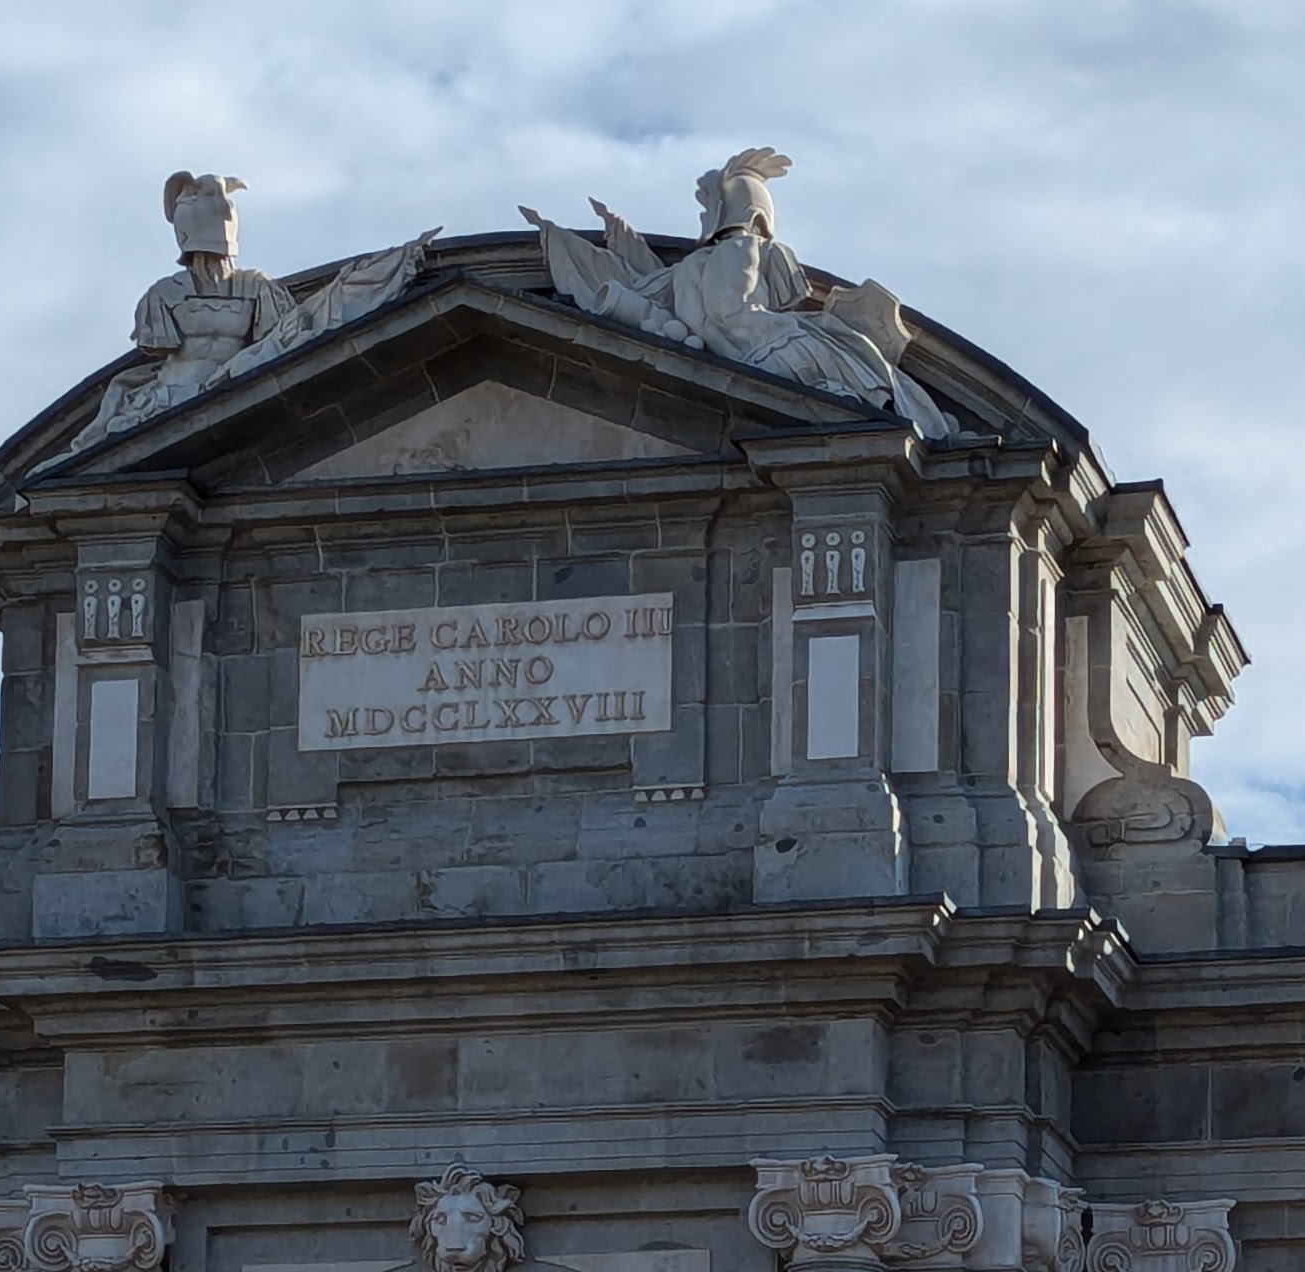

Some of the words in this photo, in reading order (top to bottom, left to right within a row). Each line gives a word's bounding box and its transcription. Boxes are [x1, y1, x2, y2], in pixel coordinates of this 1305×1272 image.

[301, 622, 417, 658] REGE
[430, 609, 612, 650] CAROLO
[624, 607, 673, 638] III
[416, 655, 554, 692] ANNO
[324, 690, 646, 738] MDCCLXXVIII
